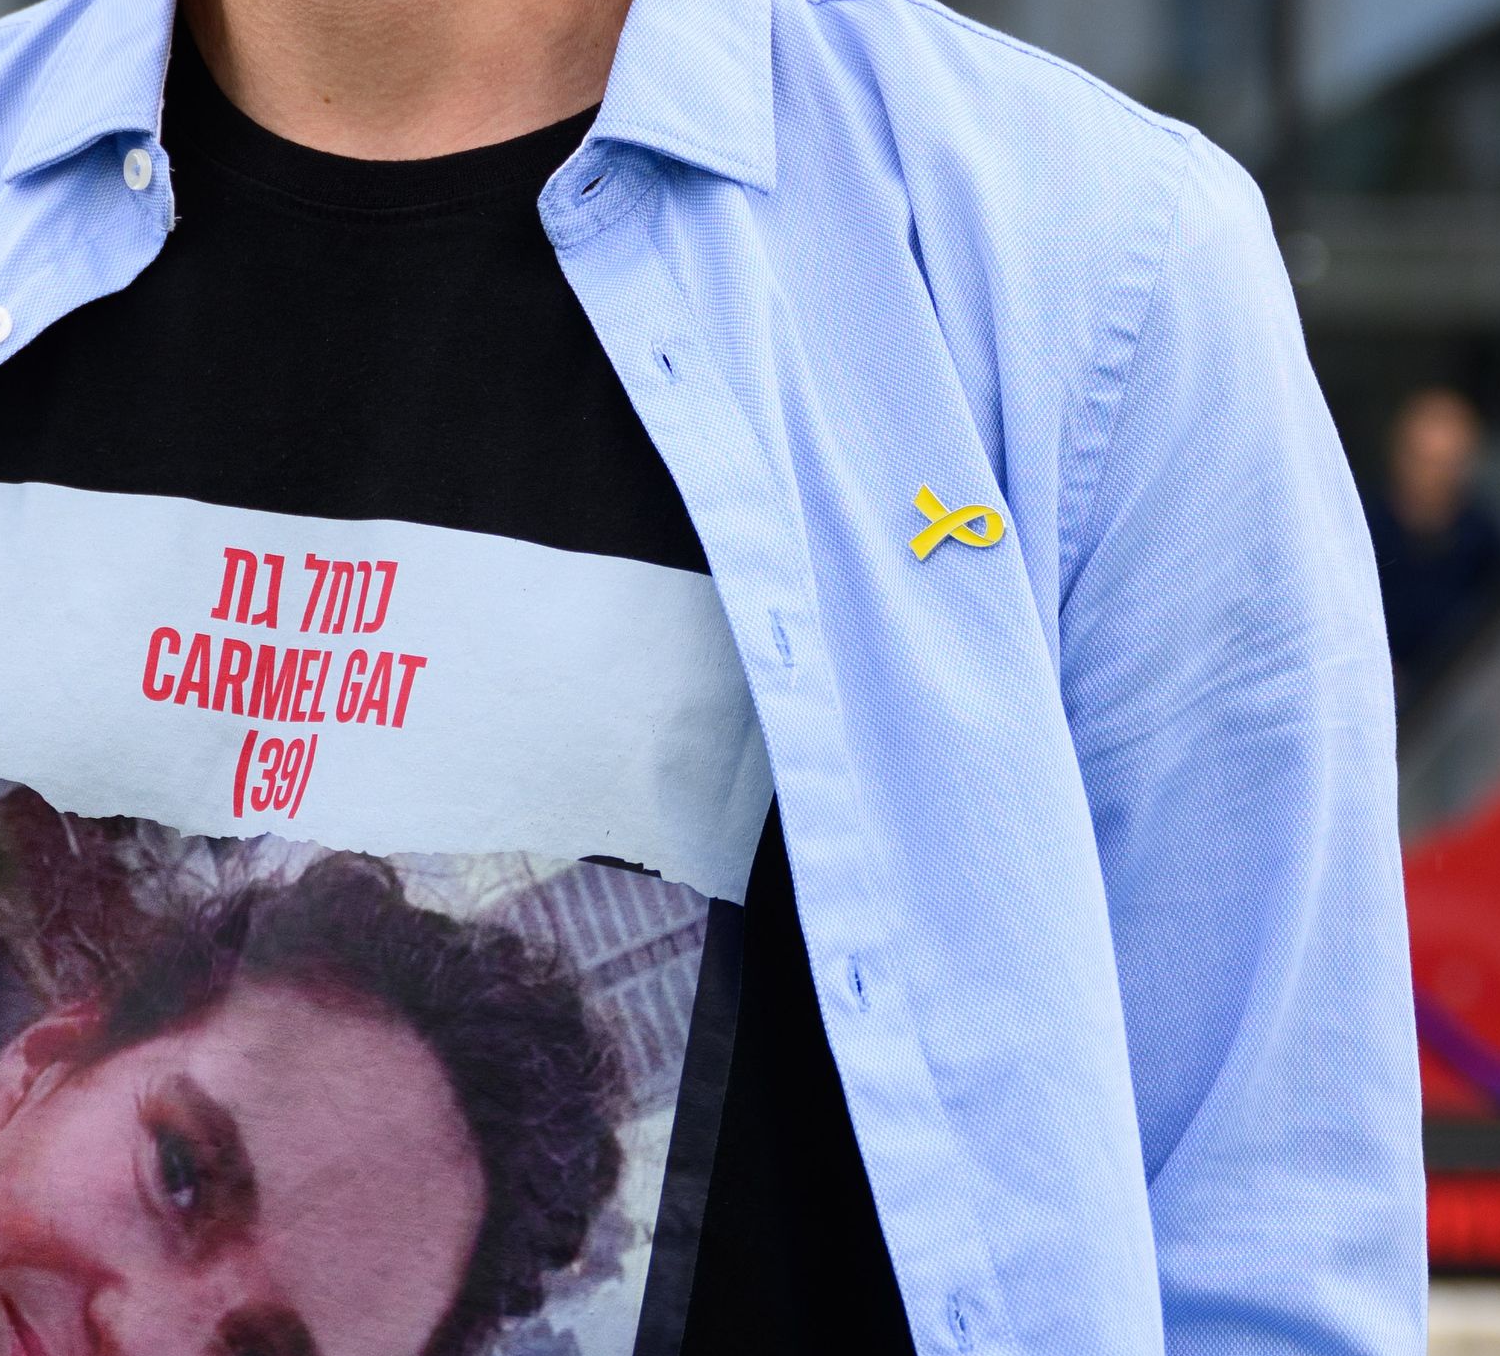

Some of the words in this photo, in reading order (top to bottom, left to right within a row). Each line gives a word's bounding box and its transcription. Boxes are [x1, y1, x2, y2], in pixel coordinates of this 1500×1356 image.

[210, 547, 285, 630] גת
[143, 627, 333, 723] CARMEL
[335, 648, 428, 729] GAT
[233, 729, 318, 819] (39)
